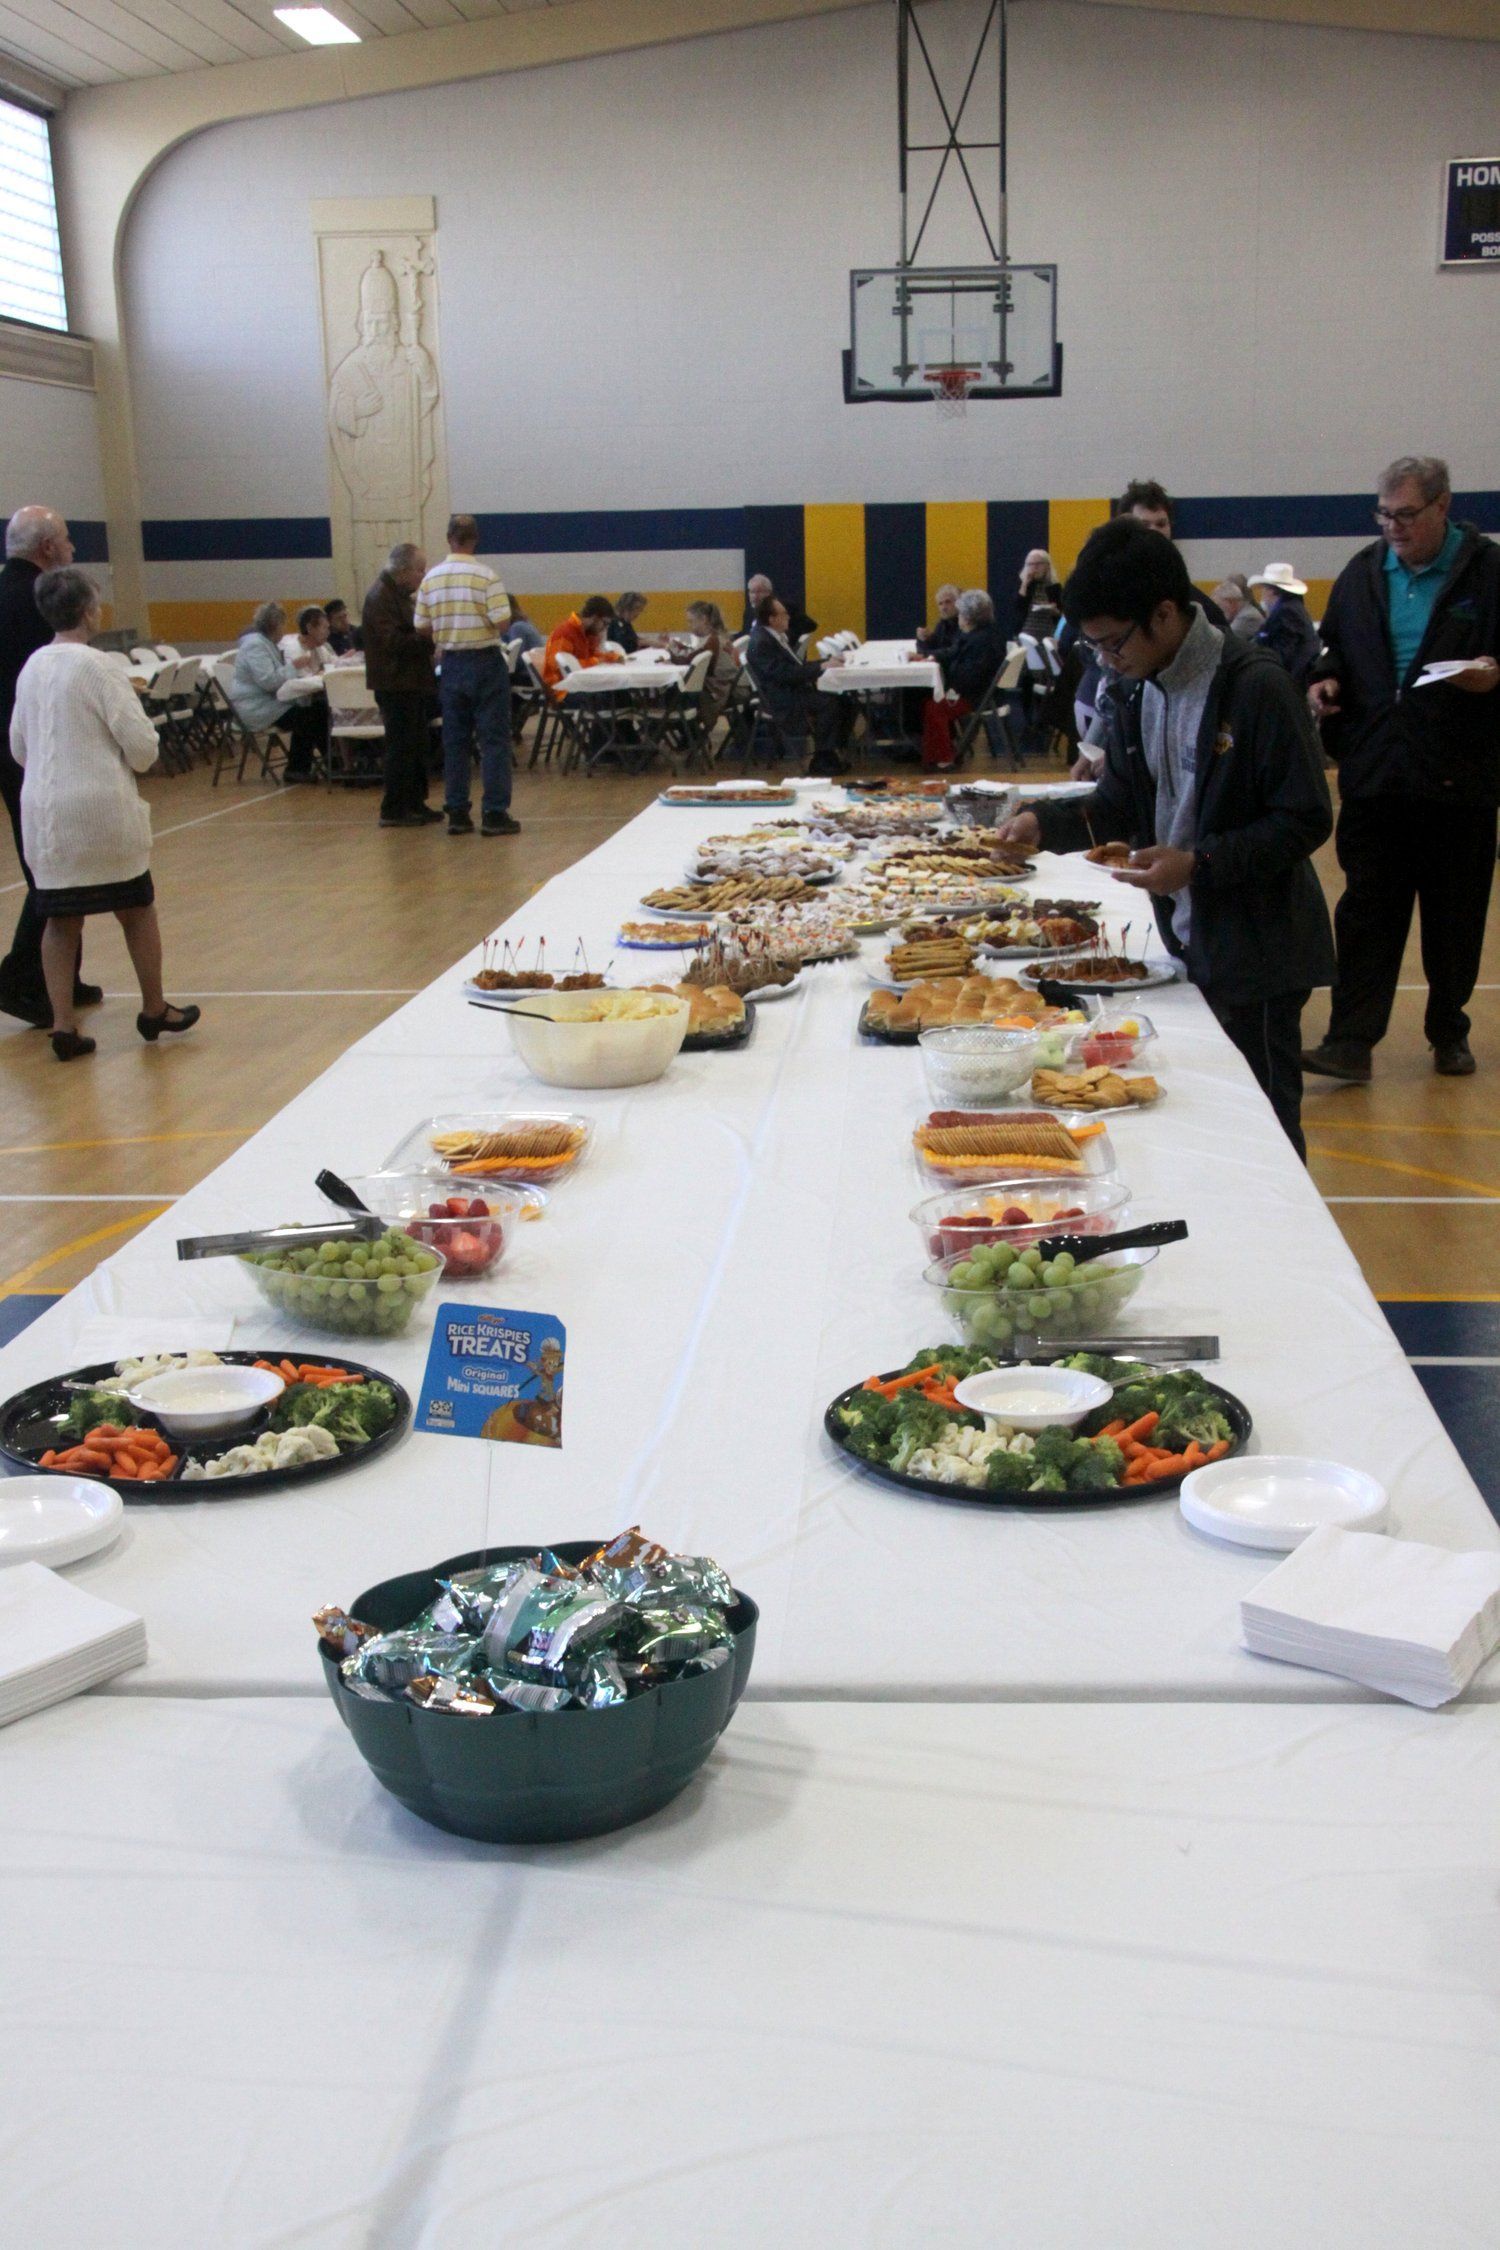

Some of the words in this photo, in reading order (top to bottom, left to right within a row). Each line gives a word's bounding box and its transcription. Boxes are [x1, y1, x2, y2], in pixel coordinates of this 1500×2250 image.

[448, 1324, 475, 1335] RICE
[477, 1324, 531, 1345] KRISPIES
[449, 1336, 527, 1363] TREATS
[464, 1368, 506, 1380] Original
[447, 1375, 470, 1393] Mini
[472, 1383, 520, 1398] SQUARES
